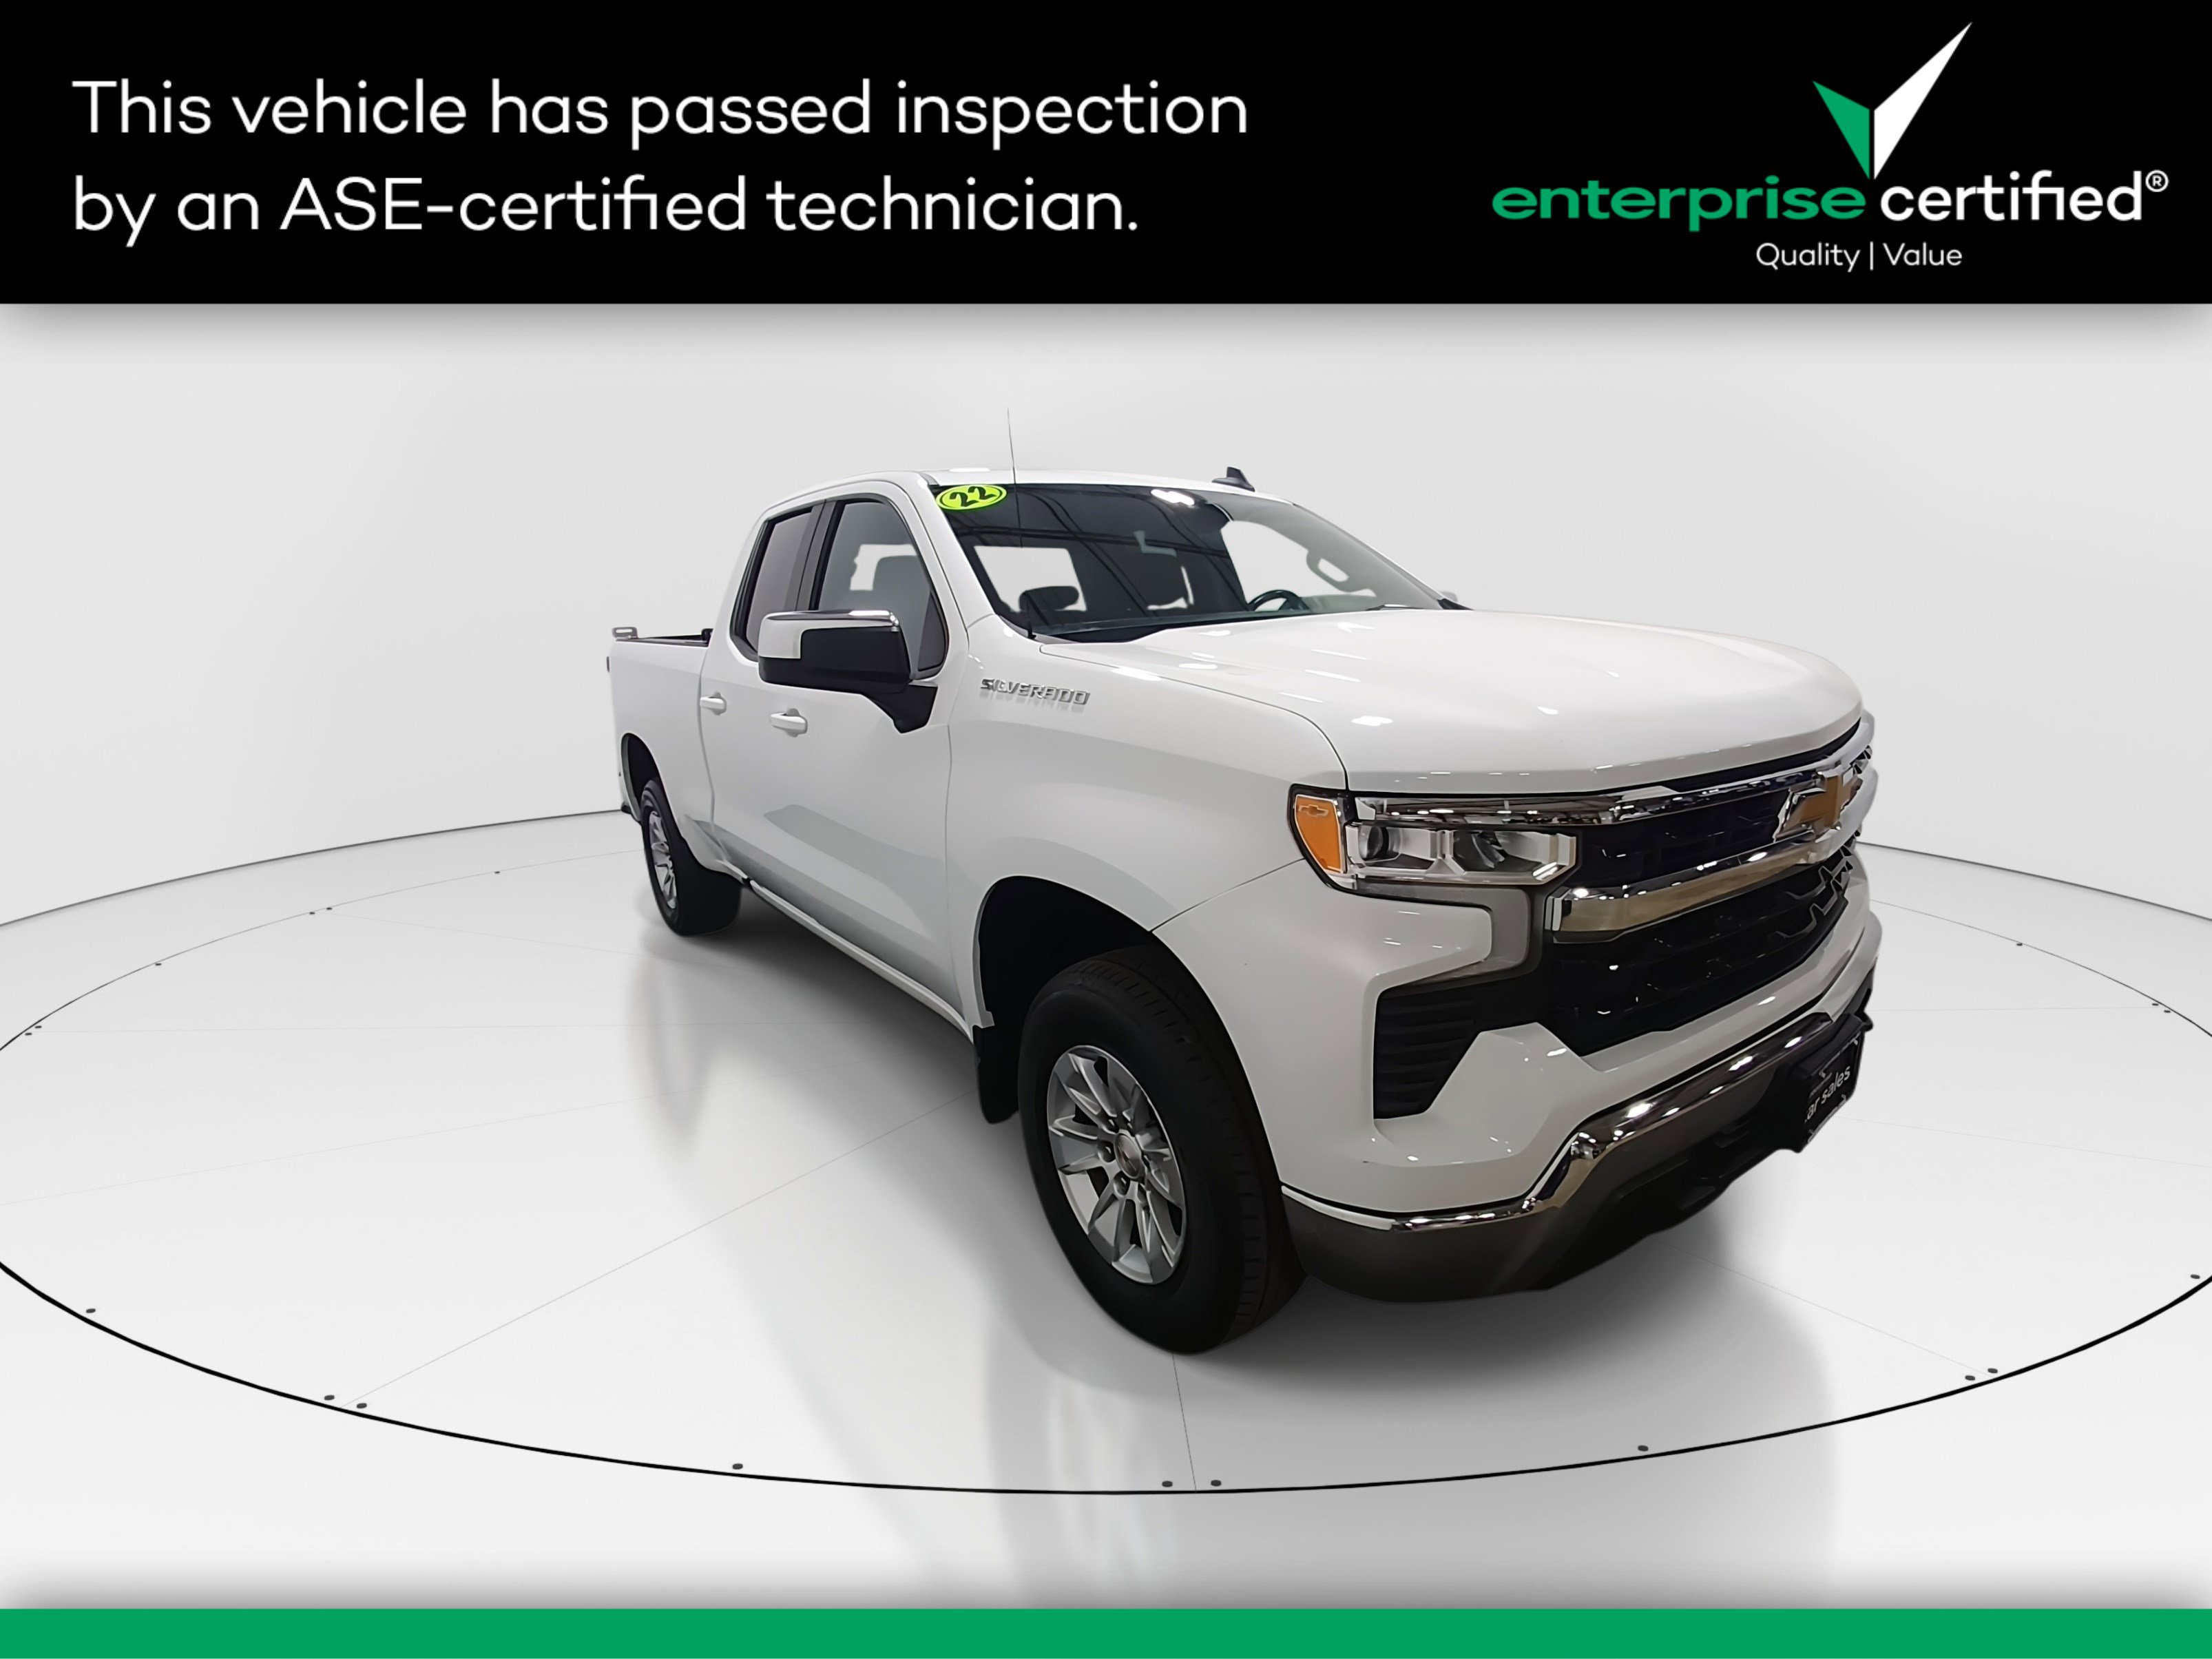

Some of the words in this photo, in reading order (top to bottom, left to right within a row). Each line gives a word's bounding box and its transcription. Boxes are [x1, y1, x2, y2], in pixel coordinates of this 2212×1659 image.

[949, 486, 997, 507] 22
[980, 679, 1090, 705] SILVERADO
[1821, 1065, 1850, 1104] sales
